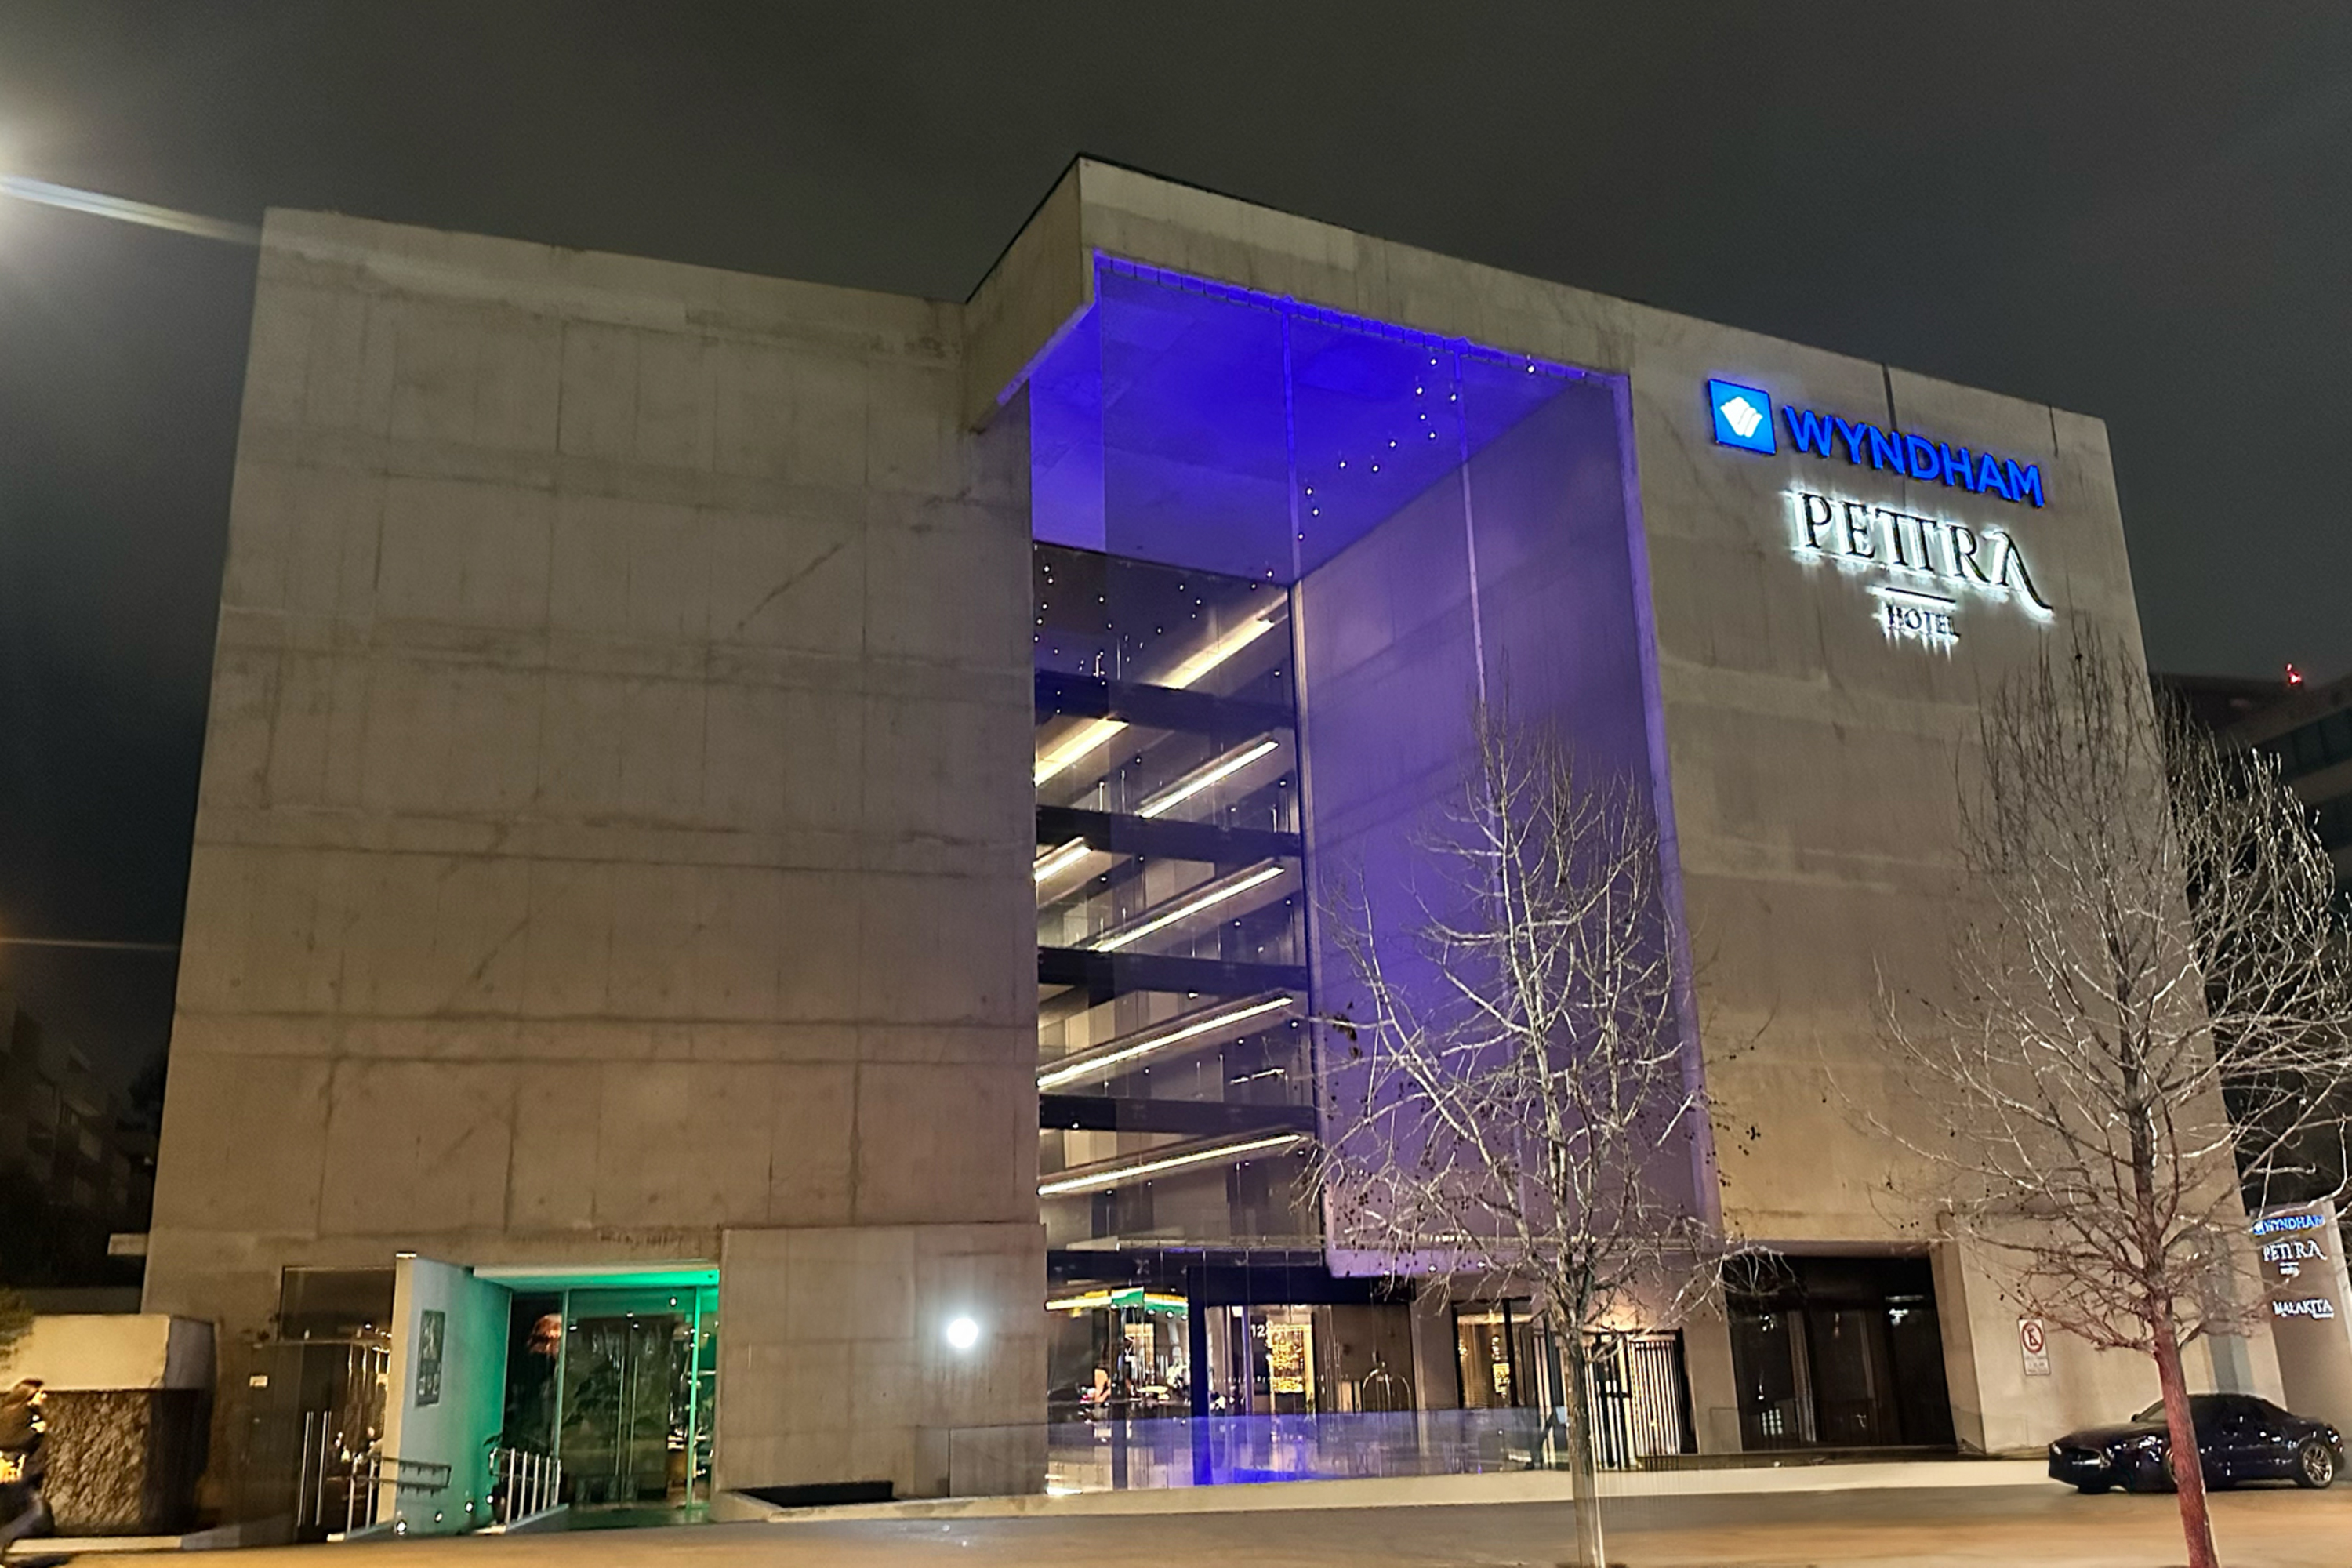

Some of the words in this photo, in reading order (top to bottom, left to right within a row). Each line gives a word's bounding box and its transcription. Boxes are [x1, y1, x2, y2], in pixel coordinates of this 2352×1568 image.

[1783, 405, 2045, 508] WYNDHAM
[1886, 604, 1962, 640] HOTEL
[2263, 1215, 2325, 1233] WYNDHAM
